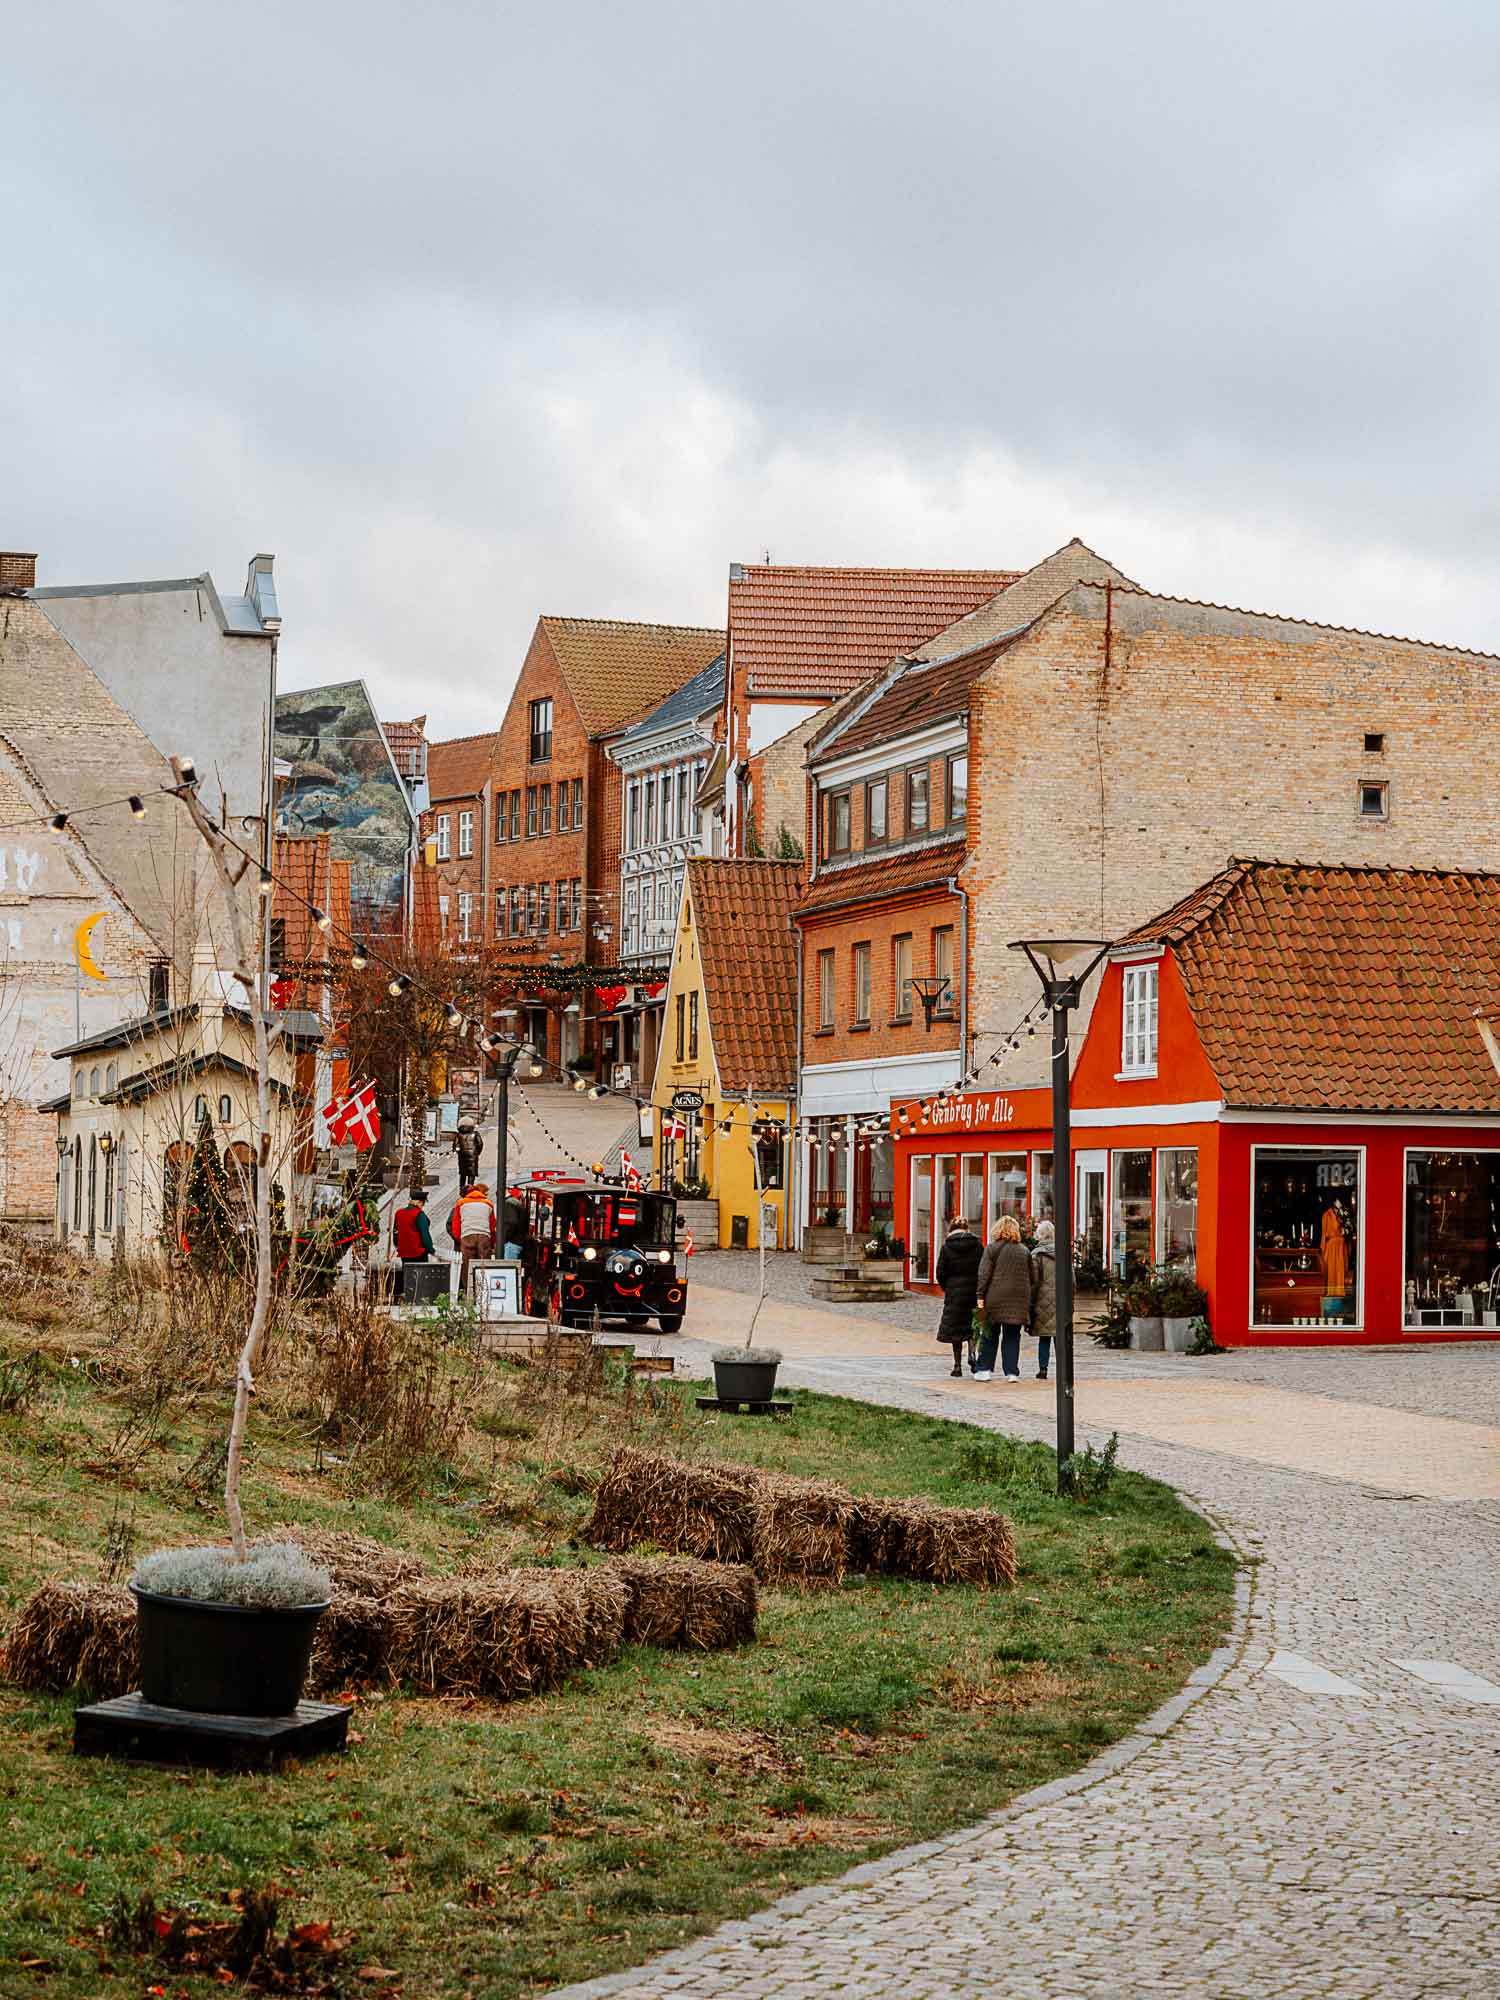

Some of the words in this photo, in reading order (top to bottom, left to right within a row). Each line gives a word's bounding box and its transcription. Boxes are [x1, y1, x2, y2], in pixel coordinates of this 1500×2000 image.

[674, 1096, 702, 1105] AGNES
[932, 1099, 973, 1128] Genbrug
[974, 1098, 989, 1126] for
[992, 1096, 1014, 1123] Alle
